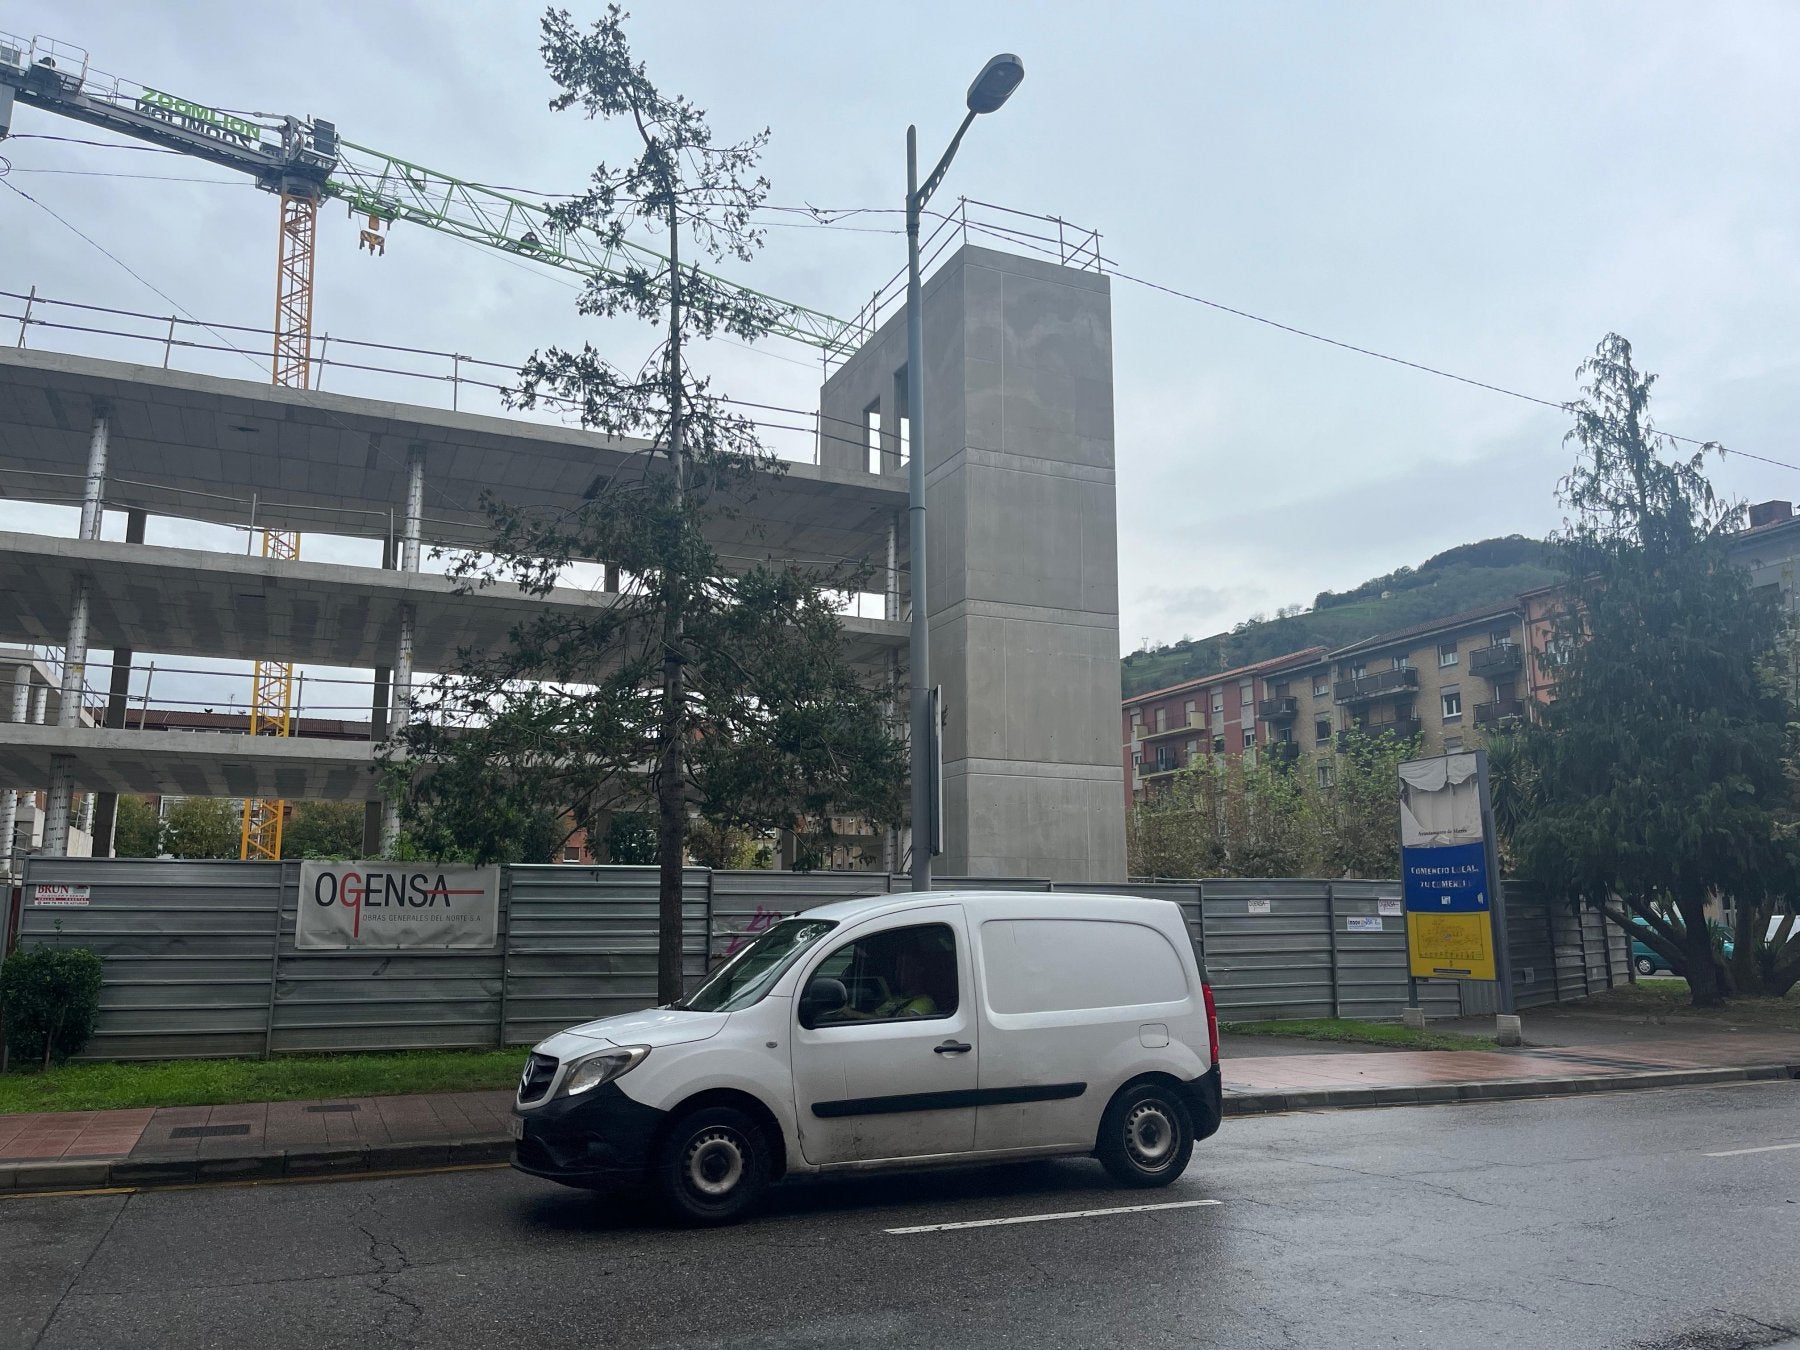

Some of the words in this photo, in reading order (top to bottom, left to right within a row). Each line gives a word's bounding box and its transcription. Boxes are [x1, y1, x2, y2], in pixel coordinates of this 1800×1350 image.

[140, 86, 261, 142] ZOOMLION
[37, 884, 70, 894] BRUN
[1431, 879, 1472, 889] CMERI
[315, 872, 451, 908] OGENSA
[362, 914, 386, 922] OBRAS
[388, 914, 429, 922] GENERALES
[430, 914, 443, 922] DEL
